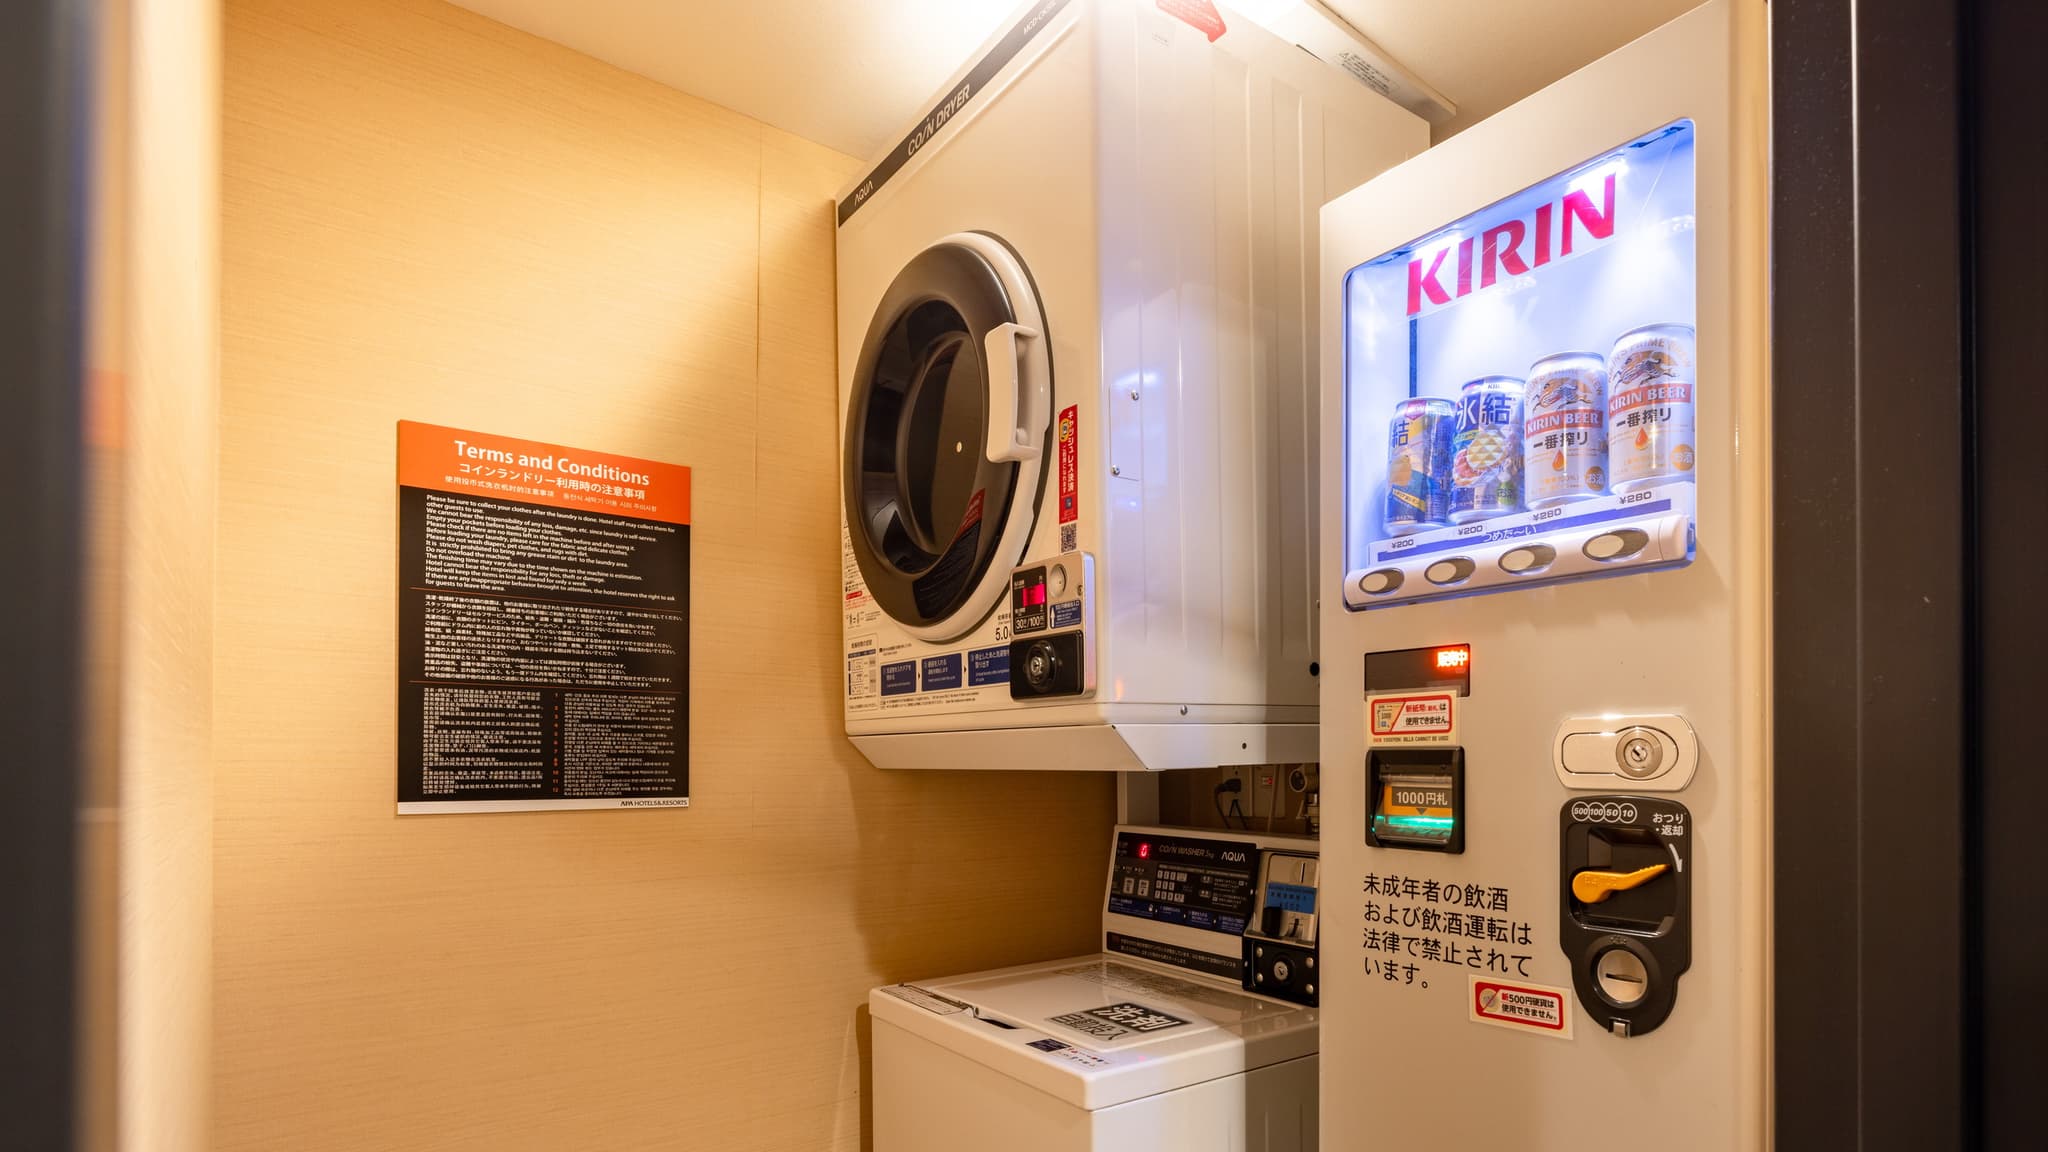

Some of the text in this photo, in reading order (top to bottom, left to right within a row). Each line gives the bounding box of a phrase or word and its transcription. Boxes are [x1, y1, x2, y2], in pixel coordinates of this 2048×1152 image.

[936, 84, 970, 128] DRYER
[853, 180, 874, 206] AQUA
[1406, 172, 1616, 316] KIRIN
[1609, 386, 1686, 413] KIRIN BEER
[1456, 393, 1513, 431] 氷結
[1527, 412, 1600, 435] KIRIN BEER
[1615, 407, 1672, 428] 一番搾り
[1533, 432, 1589, 450] 一番搾り
[454, 440, 650, 486] Terms and Conditions
[459, 462, 646, 500] コインランドリー利用時の注意事項
[1619, 490, 1653, 506] ¥280
[1532, 507, 1562, 522] ¥280
[1457, 524, 1484, 536] ¥200
[1391, 538, 1415, 550] ¥200
[1396, 791, 1448, 806] 1000円札
[1590, 808, 1603, 816] 100
[1606, 809, 1619, 817] 50
[1622, 809, 1634, 817] 10
[1652, 812, 1685, 824] おつり
[1178, 846, 1205, 857] WASHER
[1221, 851, 1246, 864] AQUA
[1363, 872, 1509, 912] 未成年者の飲酒
[1364, 900, 1533, 946] および飲酒運転は
[1363, 927, 1533, 978] 法律で禁止されて
[1364, 956, 1429, 989] います。
[1093, 1004, 1181, 1031] 洗剤
[1501, 1004, 1557, 1021] 使用できません。
